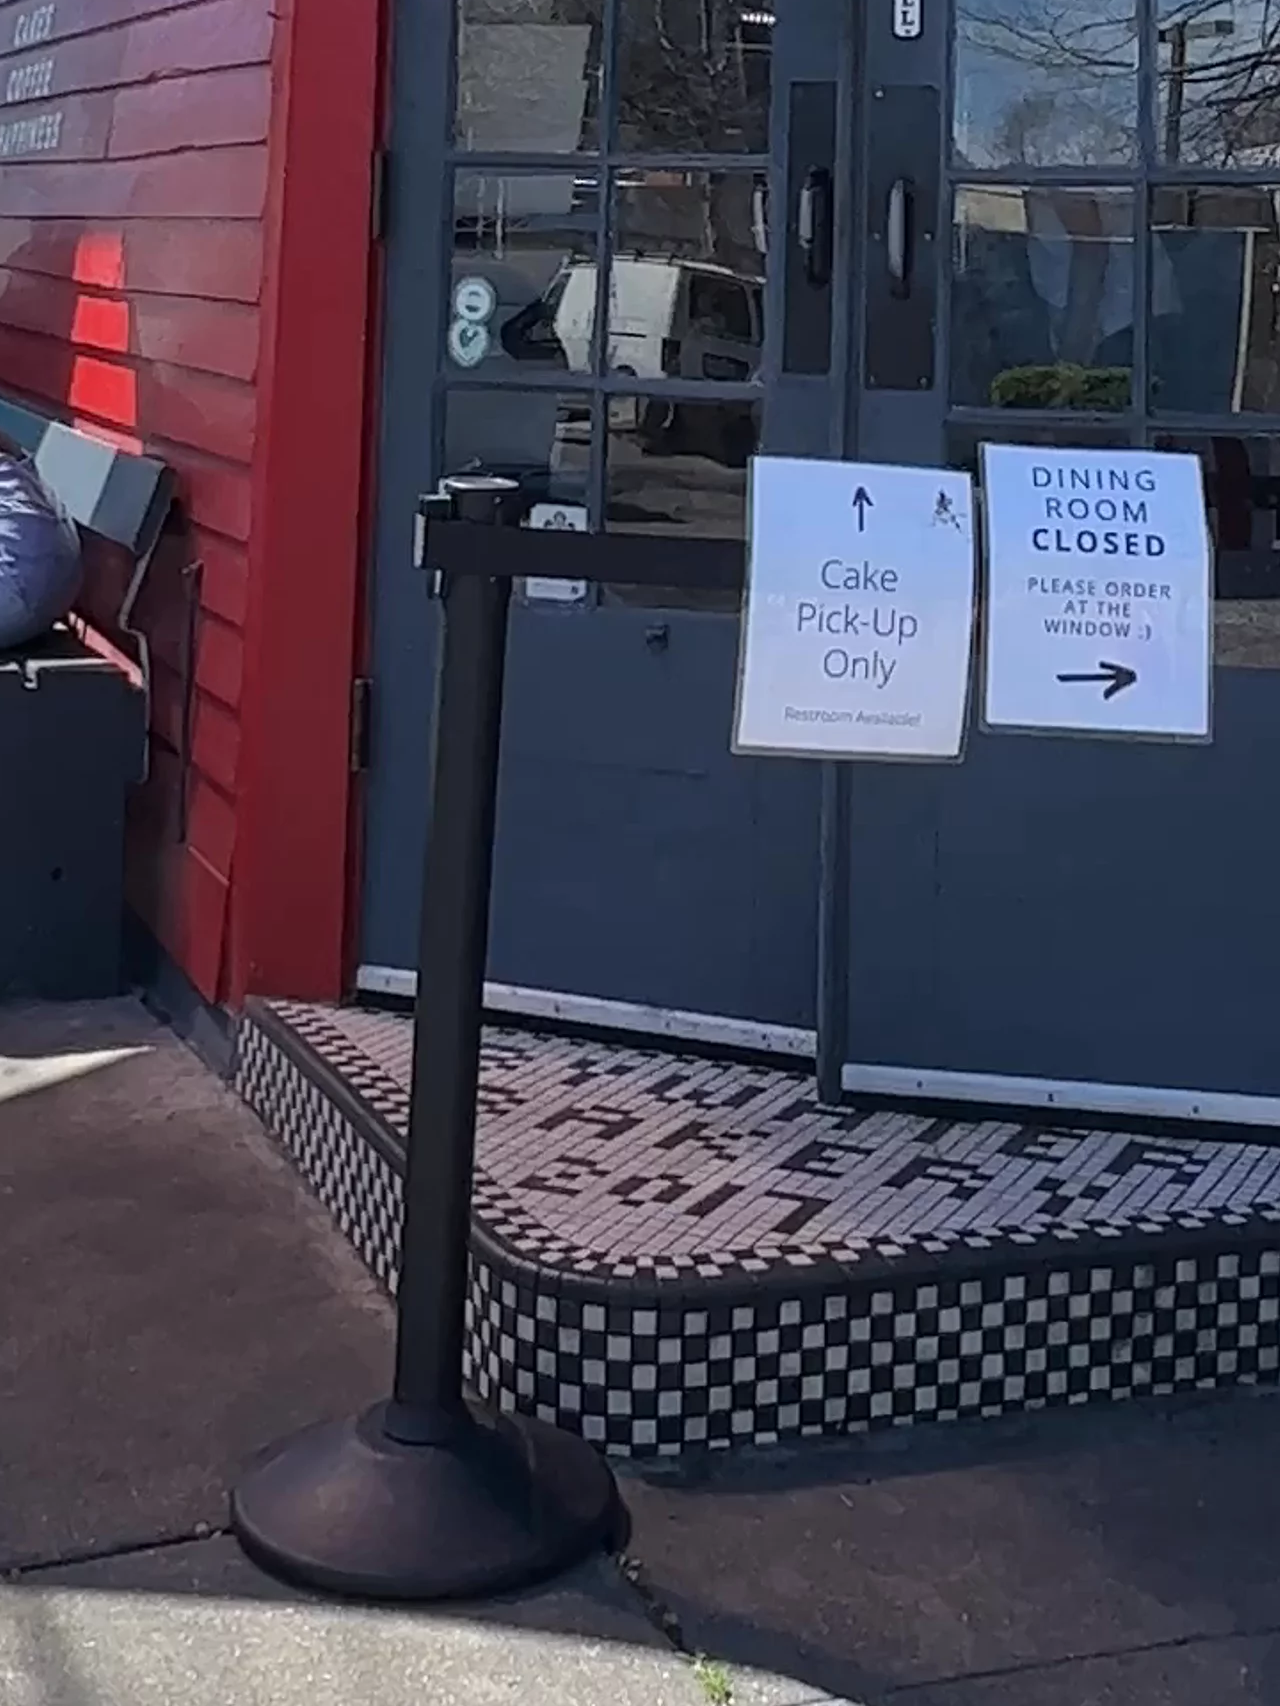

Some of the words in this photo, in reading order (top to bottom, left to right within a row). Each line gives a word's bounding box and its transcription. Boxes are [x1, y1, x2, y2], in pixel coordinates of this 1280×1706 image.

[14, 3, 56, 48] CAKES
[6, 58, 55, 102] COFFEE
[1031, 465, 1157, 491] DINING
[1045, 496, 1148, 523] ROOM
[1031, 527, 1166, 557] CLOSED
[820, 558, 899, 592] Cake
[1027, 577, 1097, 597] PLEASE
[1104, 581, 1172, 599] ORDER
[796, 602, 919, 645] Pick-Up
[1063, 599, 1091, 616] AT
[1096, 600, 1131, 618] THE
[1043, 618, 1131, 638] WINDOW
[822, 648, 898, 689] Only
